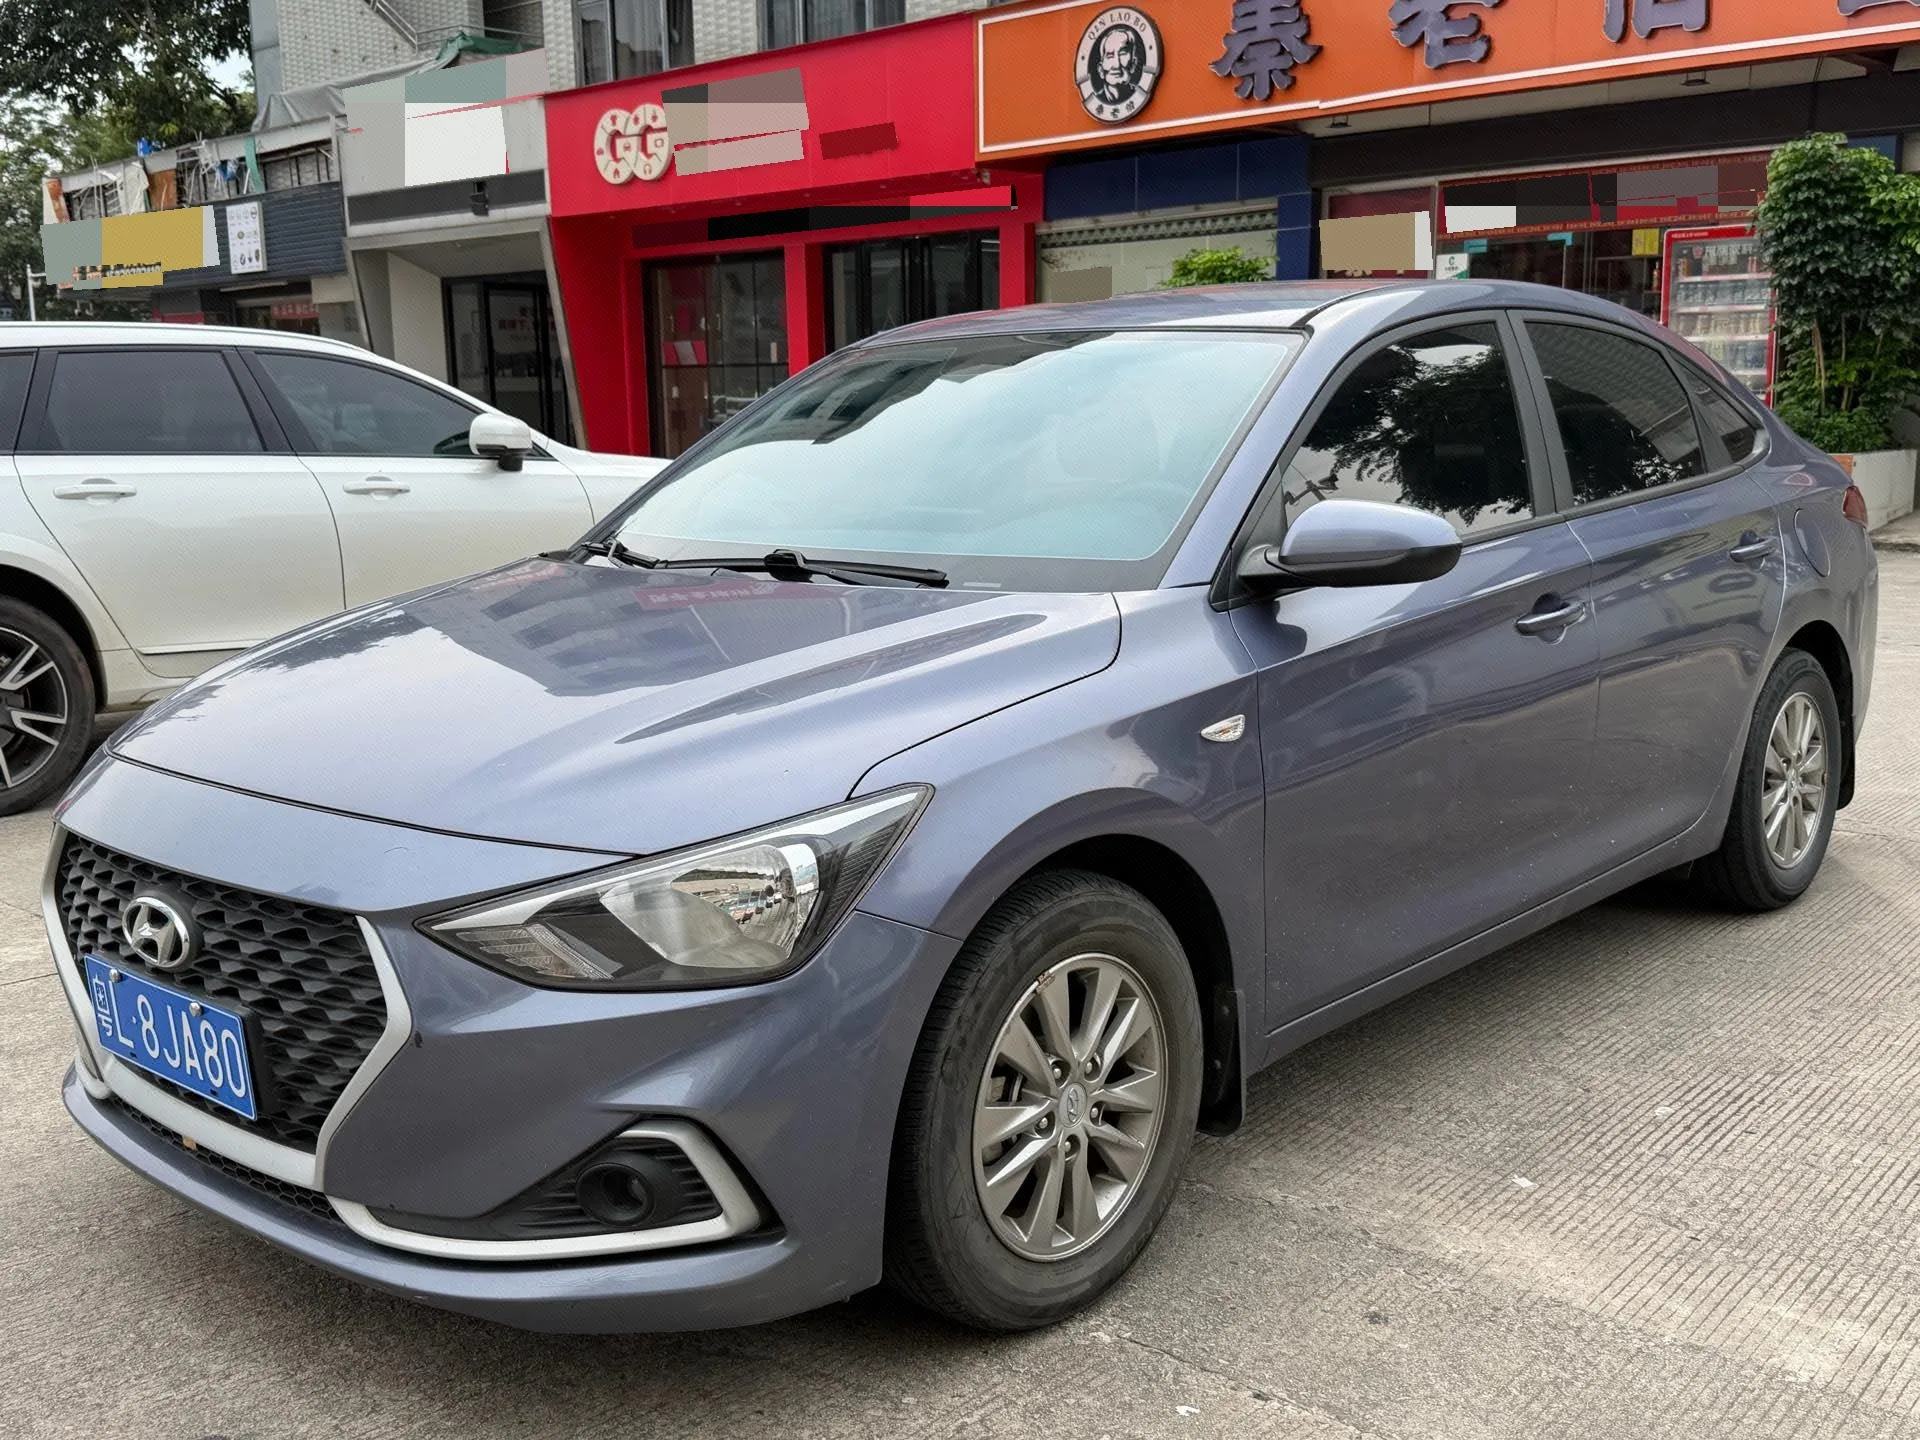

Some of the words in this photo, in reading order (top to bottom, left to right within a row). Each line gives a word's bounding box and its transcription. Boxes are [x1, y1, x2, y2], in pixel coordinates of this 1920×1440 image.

[1087, 18, 1107, 41] QIN
[1110, 12, 1131, 23] LAO
[1133, 17, 1147, 33] BO
